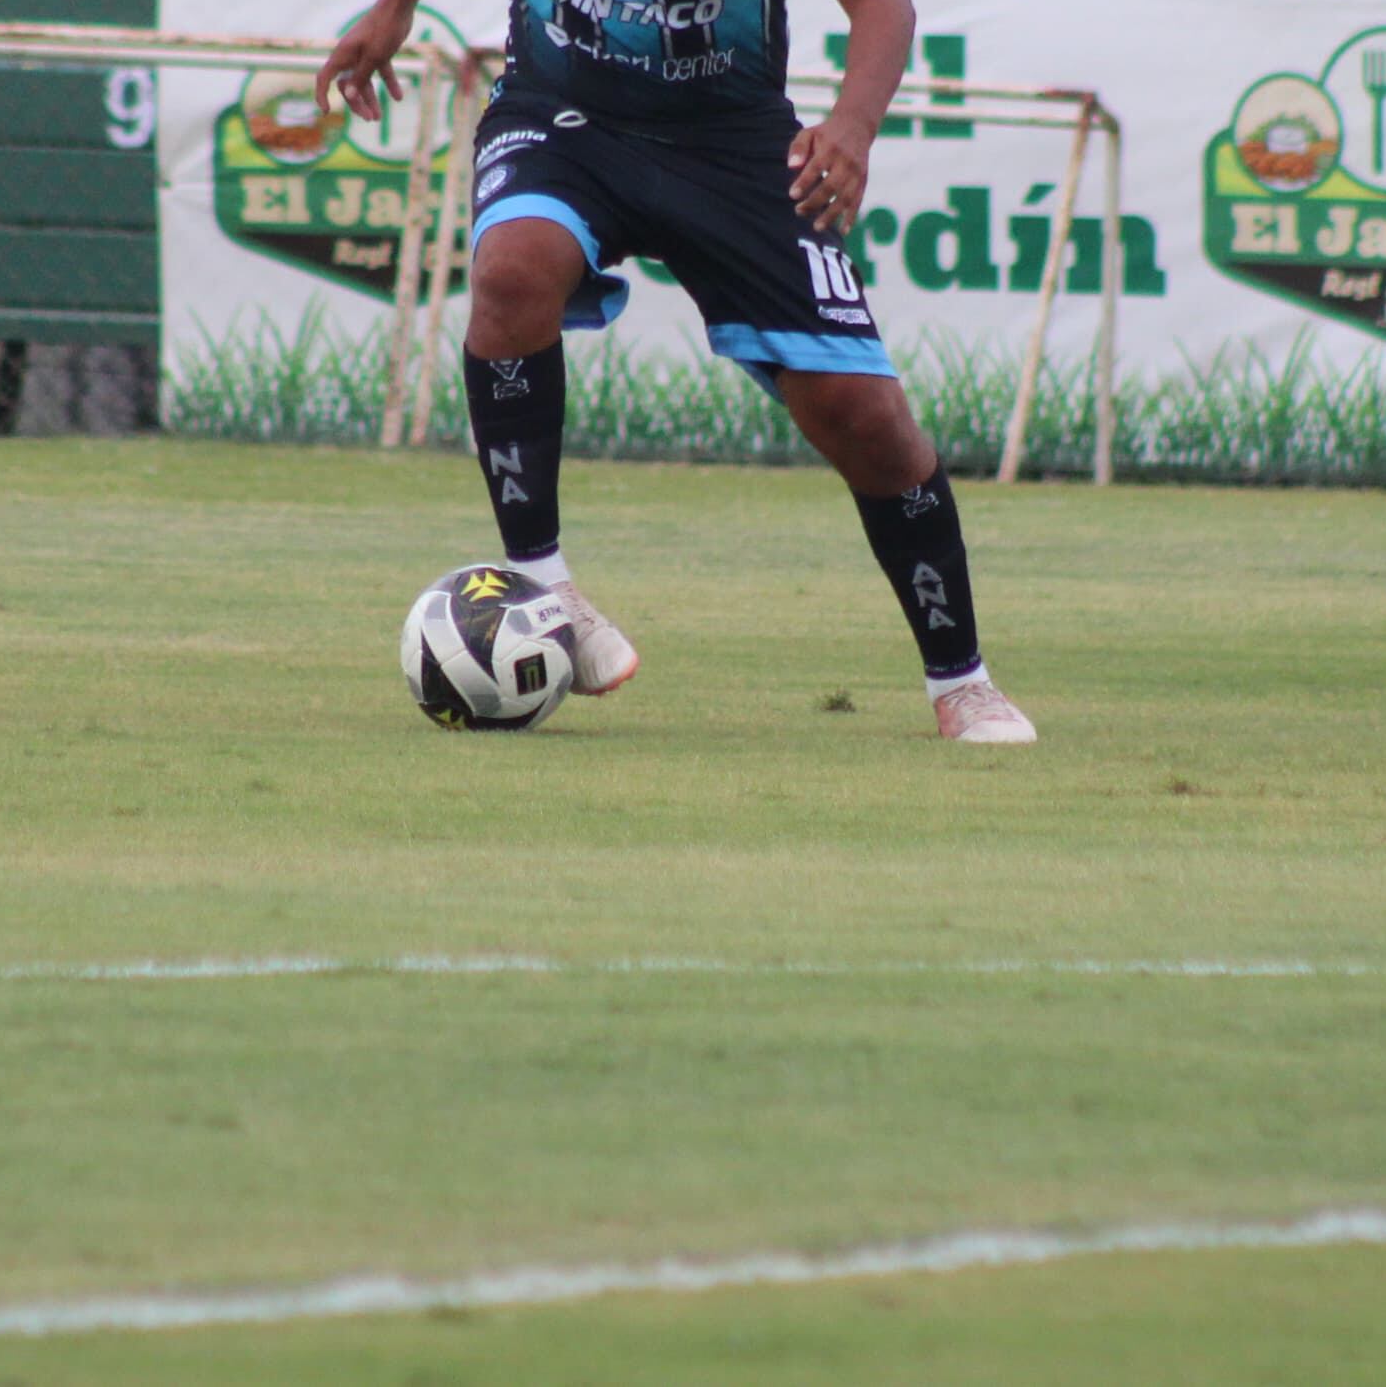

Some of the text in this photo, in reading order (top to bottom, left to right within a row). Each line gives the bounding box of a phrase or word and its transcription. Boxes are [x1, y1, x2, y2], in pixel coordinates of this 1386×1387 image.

[240, 175, 311, 224] El
[1230, 203, 1301, 254] El
[797, 238, 860, 302] 10
